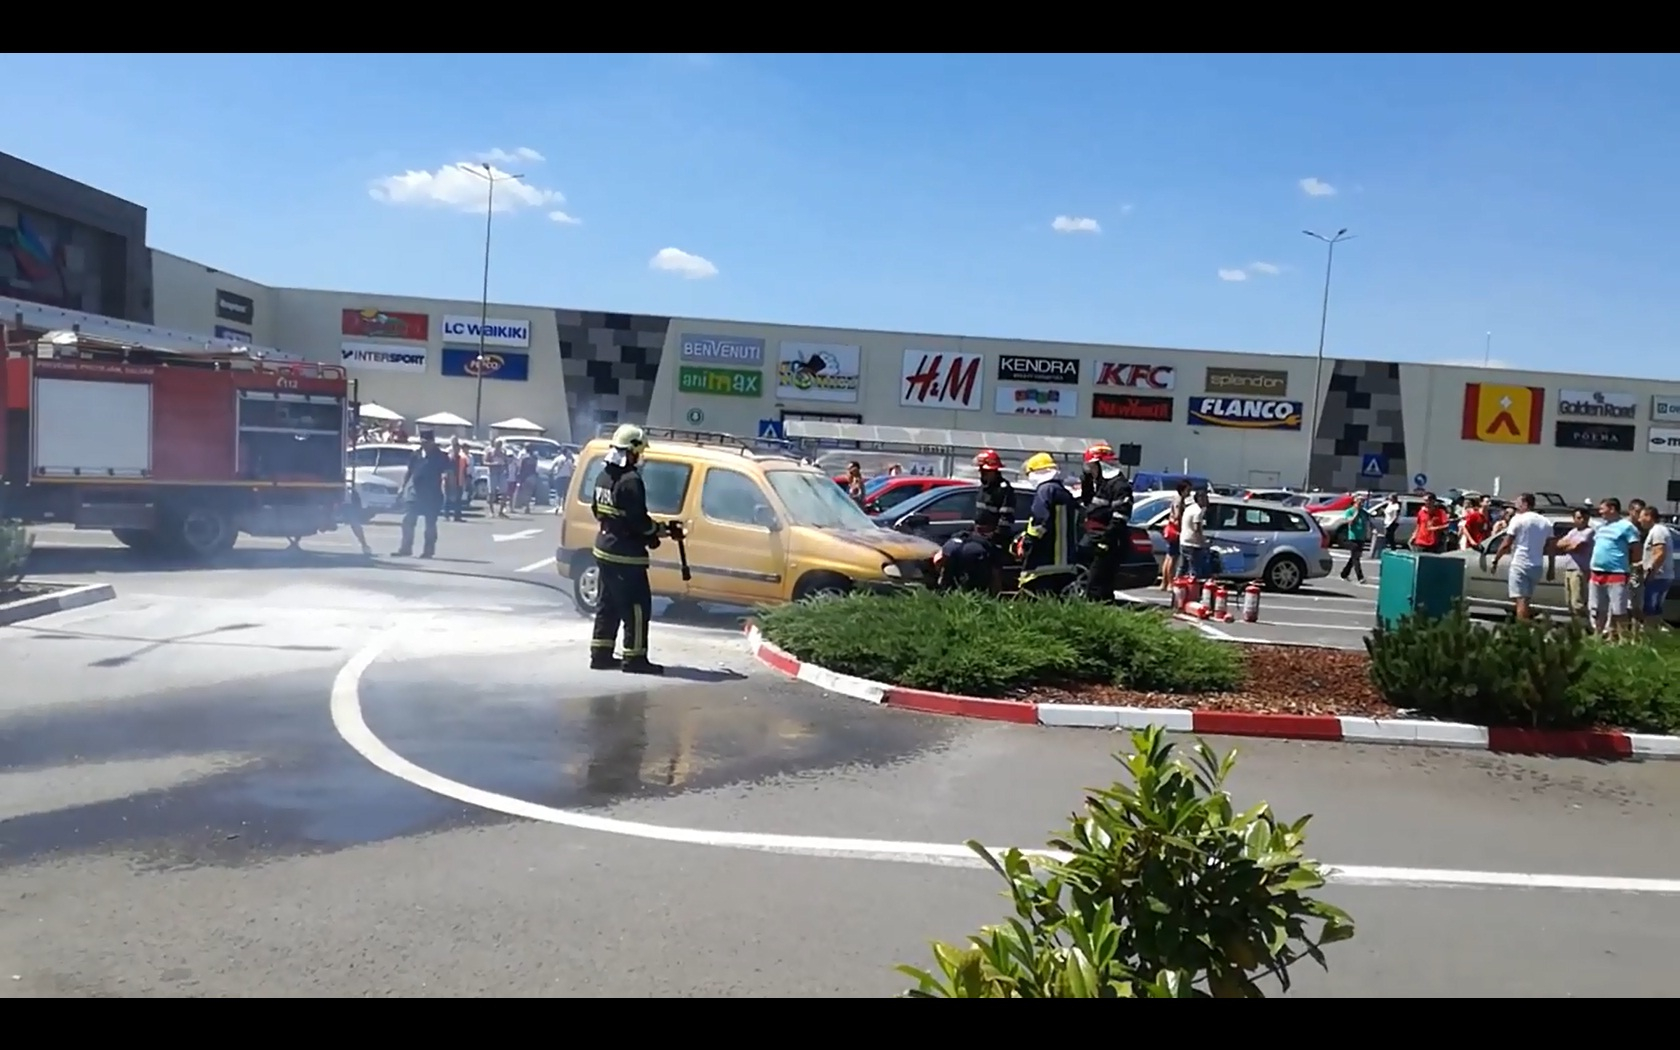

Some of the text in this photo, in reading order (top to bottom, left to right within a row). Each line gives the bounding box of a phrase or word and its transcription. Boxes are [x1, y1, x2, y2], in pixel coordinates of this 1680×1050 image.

[444, 322, 464, 335] LC
[354, 350, 425, 366] INTERSPORT
[684, 340, 760, 360] BENVENUTI
[1001, 357, 1077, 375] KENDRA
[1096, 362, 1174, 390] KFC
[682, 372, 758, 393] animax
[905, 354, 981, 406] H&M
[1200, 398, 1295, 419] FLANCO
